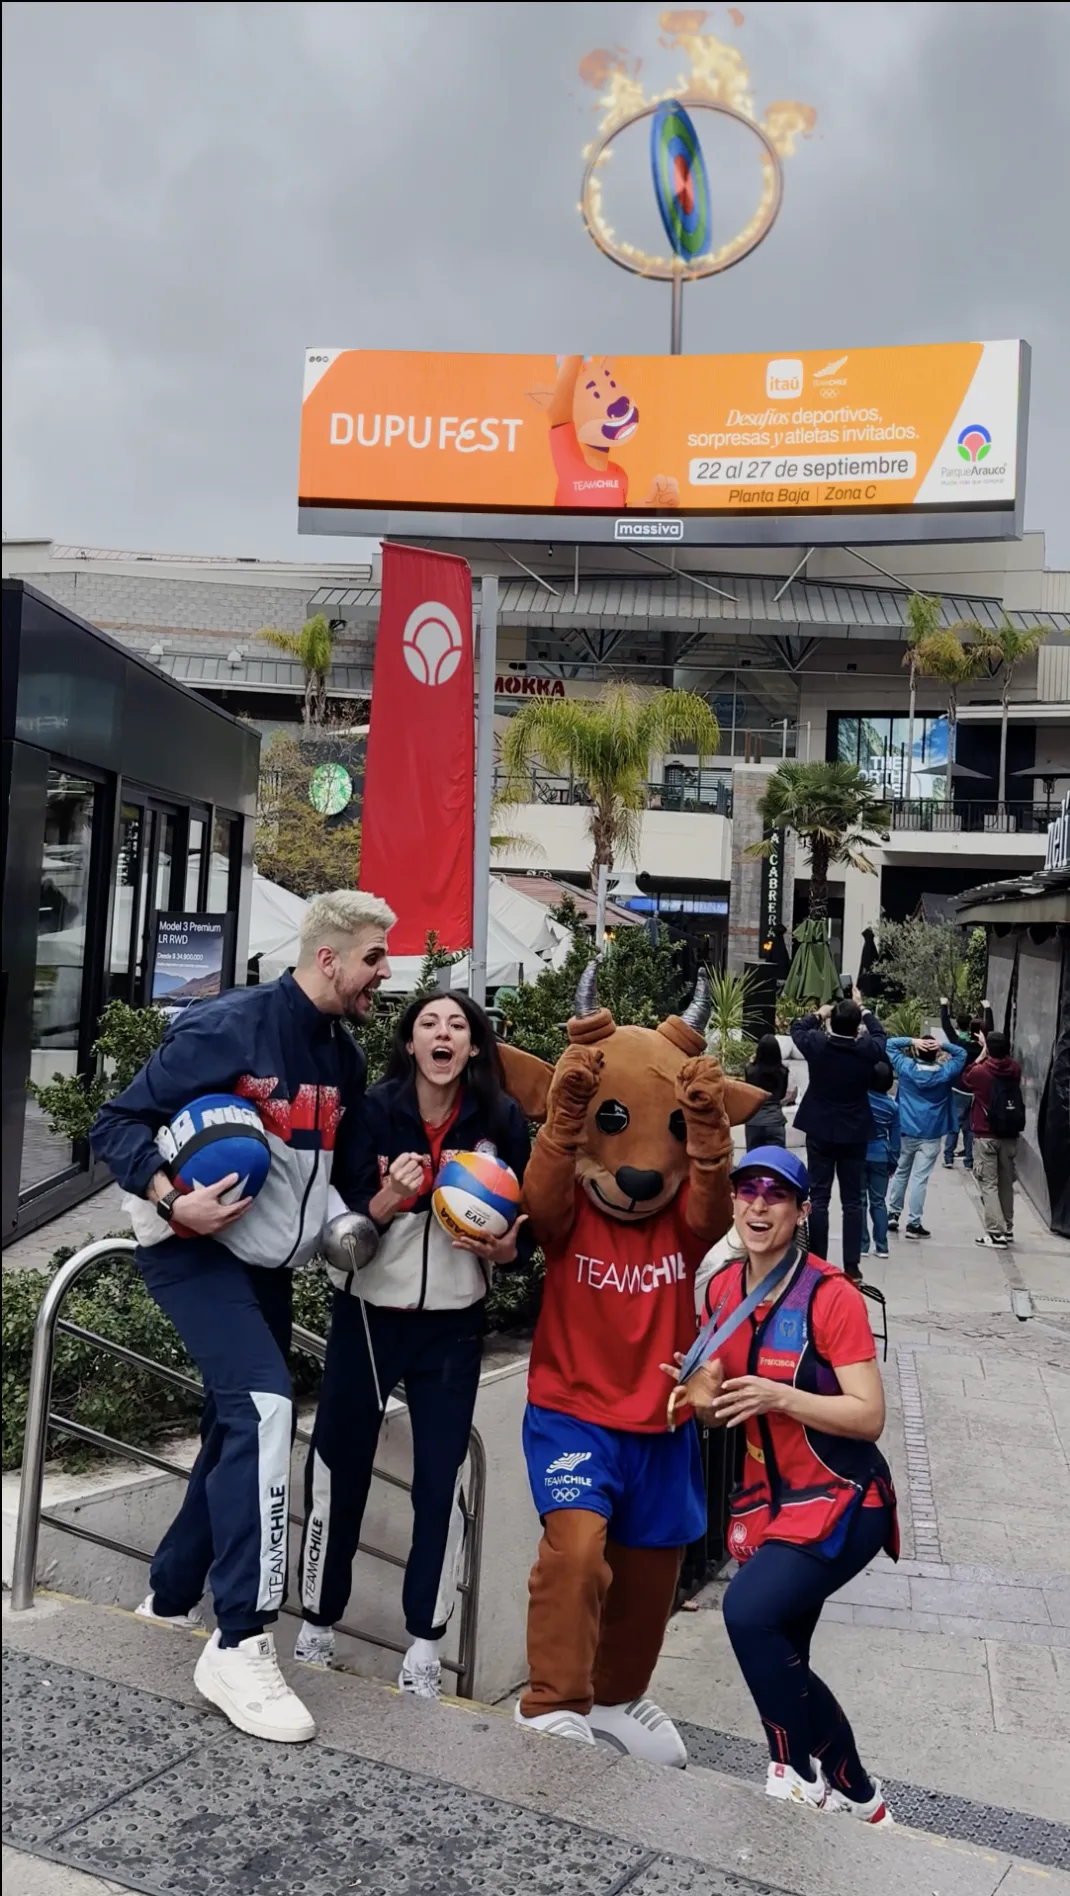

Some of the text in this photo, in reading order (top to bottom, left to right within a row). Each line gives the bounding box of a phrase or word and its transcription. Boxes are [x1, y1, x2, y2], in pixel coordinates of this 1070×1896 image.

[770, 376, 799, 392] itaú
[792, 407, 883, 427] deportivos,
[330, 412, 524, 453] DUPUFEST
[687, 423, 920, 449] sorpresas y atletas invitados.
[697, 456, 909, 479] 22 al 27 de septiembre
[572, 480, 619, 491] TEAMCHILE
[825, 485, 876, 500] Zona C
[729, 488, 810, 504] Planta Baja
[619, 522, 680, 535] massiva
[870, 755, 902, 770] THE
[857, 769, 902, 784] ORTH
[767, 853, 779, 938] CABRERA
[159, 920, 222, 932] Model 3 Premium
[158, 934, 189, 945] LR RWD
[544, 1474, 593, 1487] TEAMCHILE
[269, 1484, 286, 1598] TEAMCHILE
[305, 1516, 323, 1599] TEAMCHILE
